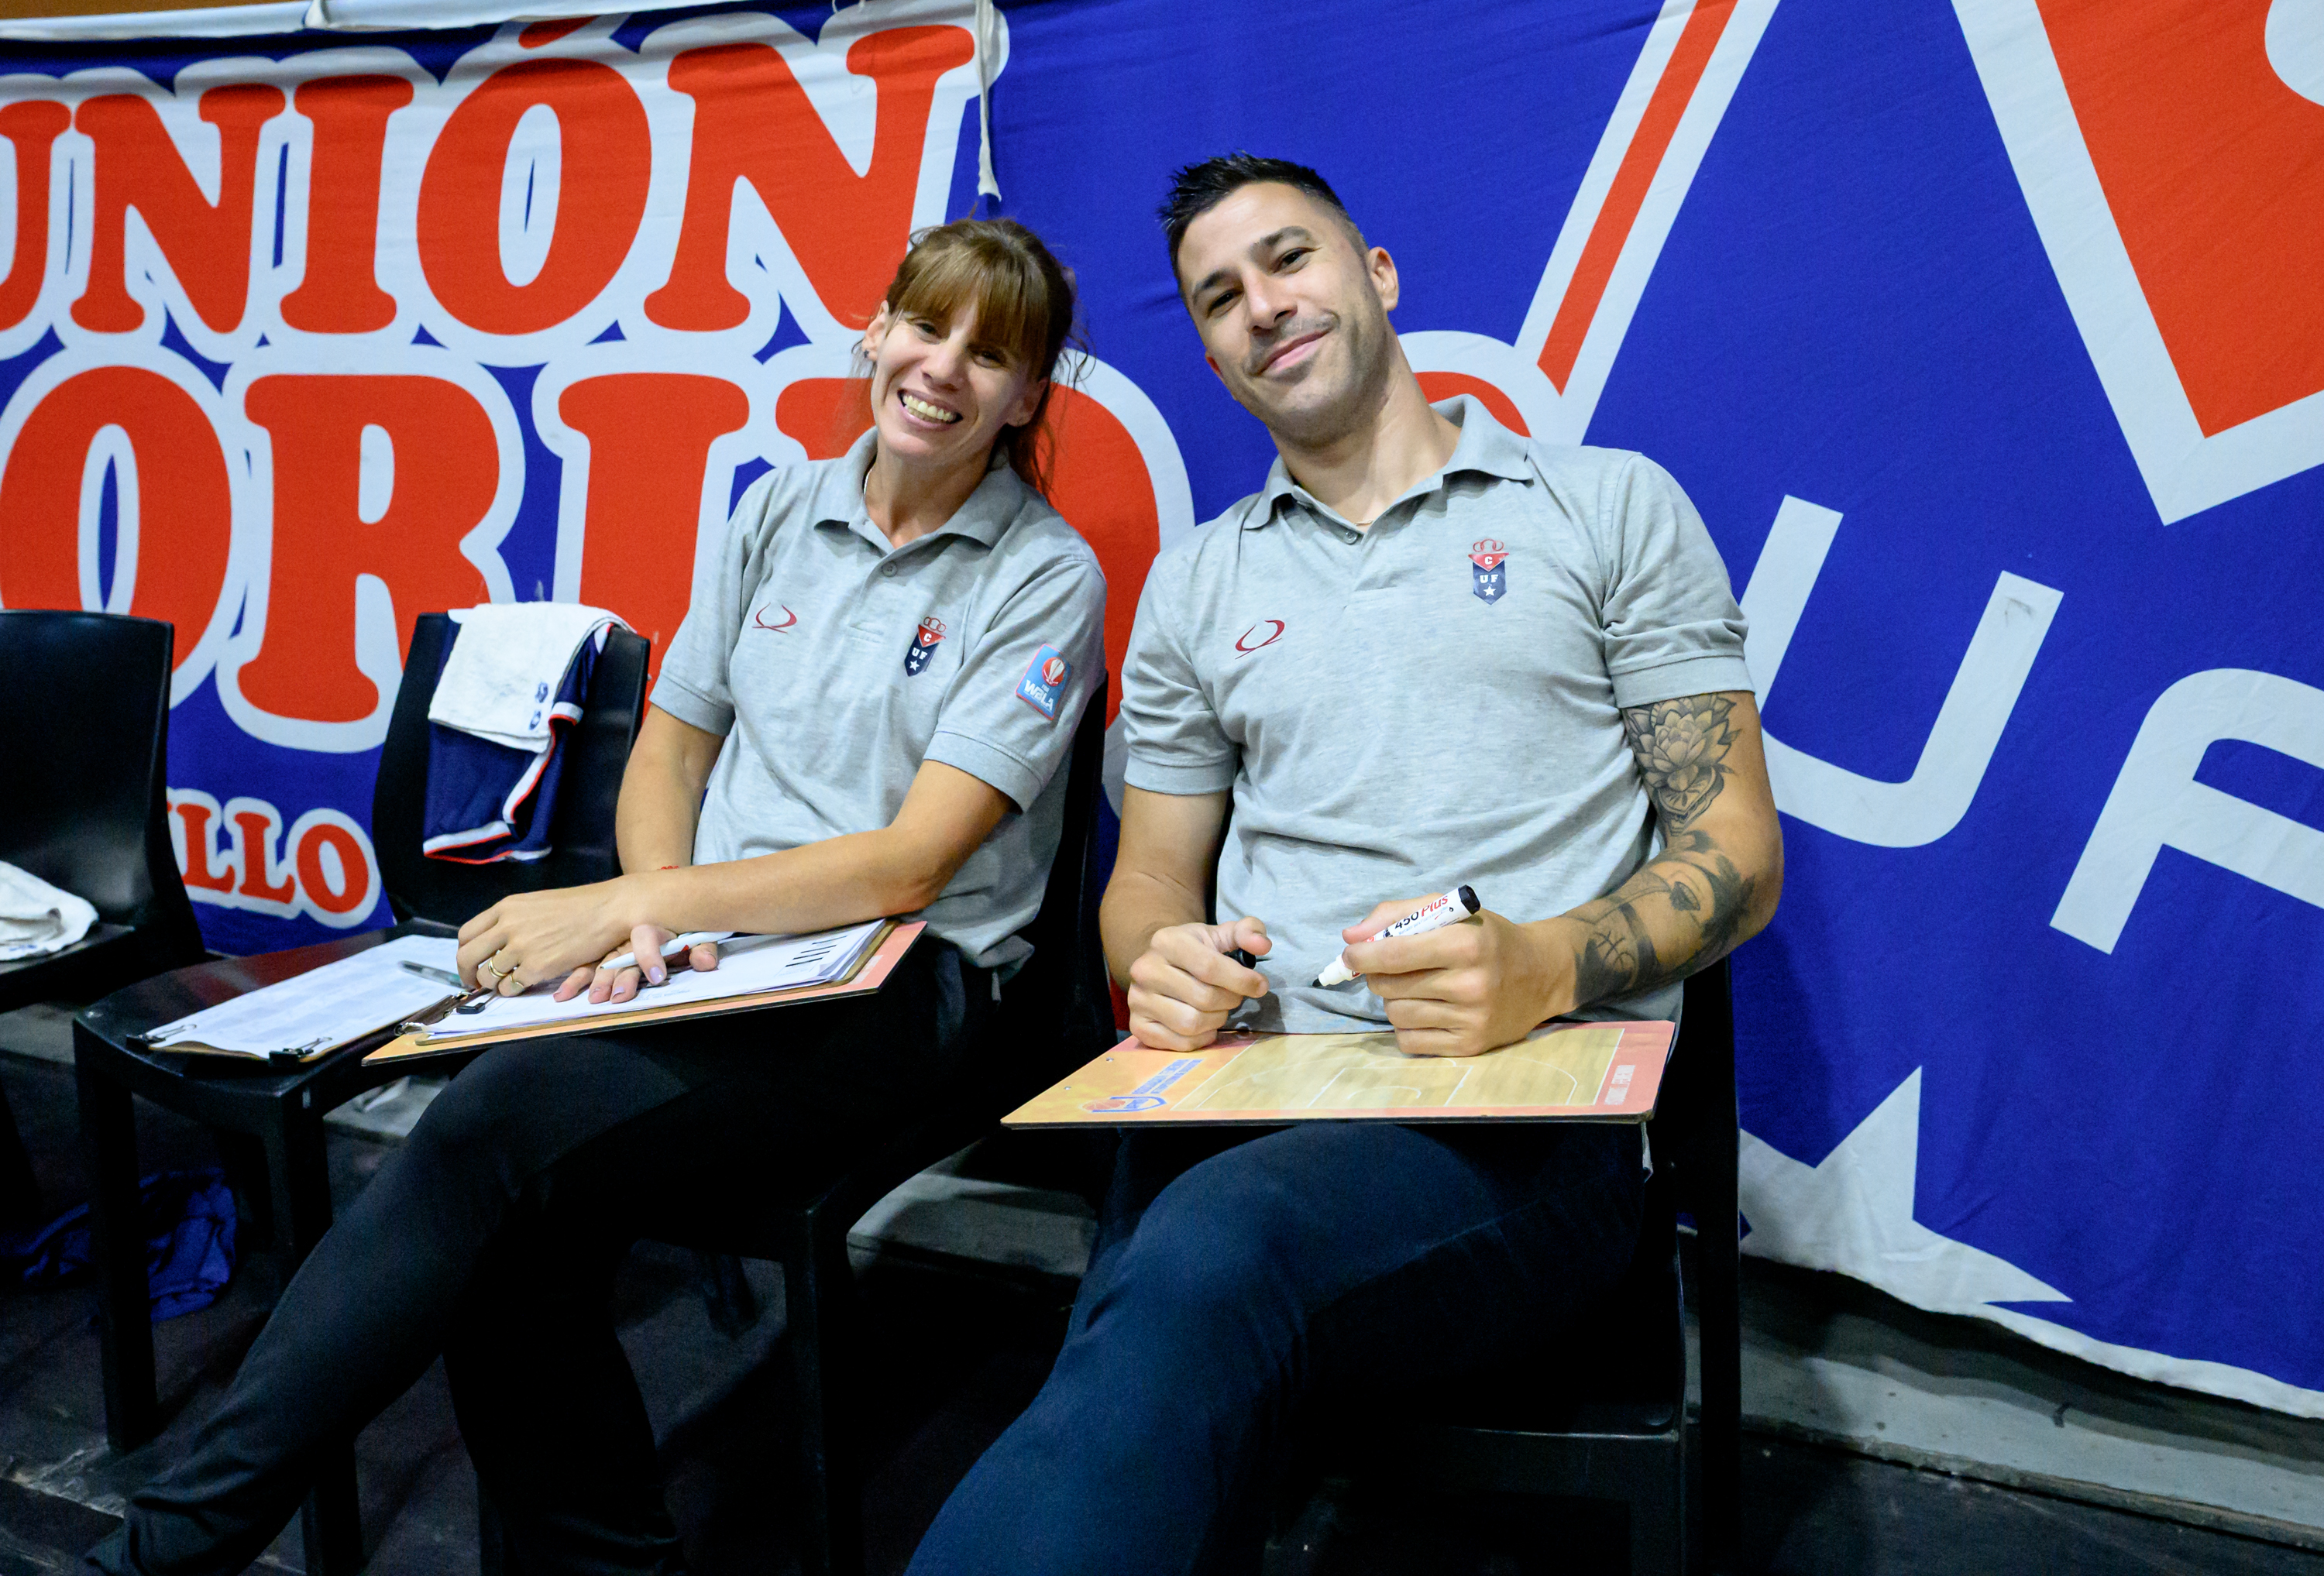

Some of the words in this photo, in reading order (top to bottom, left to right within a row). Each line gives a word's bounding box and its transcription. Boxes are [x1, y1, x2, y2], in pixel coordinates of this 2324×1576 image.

[1484, 556, 1493, 565] C
[923, 633, 932, 642] C
[166, 801, 369, 914] LLO
[1395, 912, 1418, 929] 450
[1422, 895, 1448, 917] Plus
